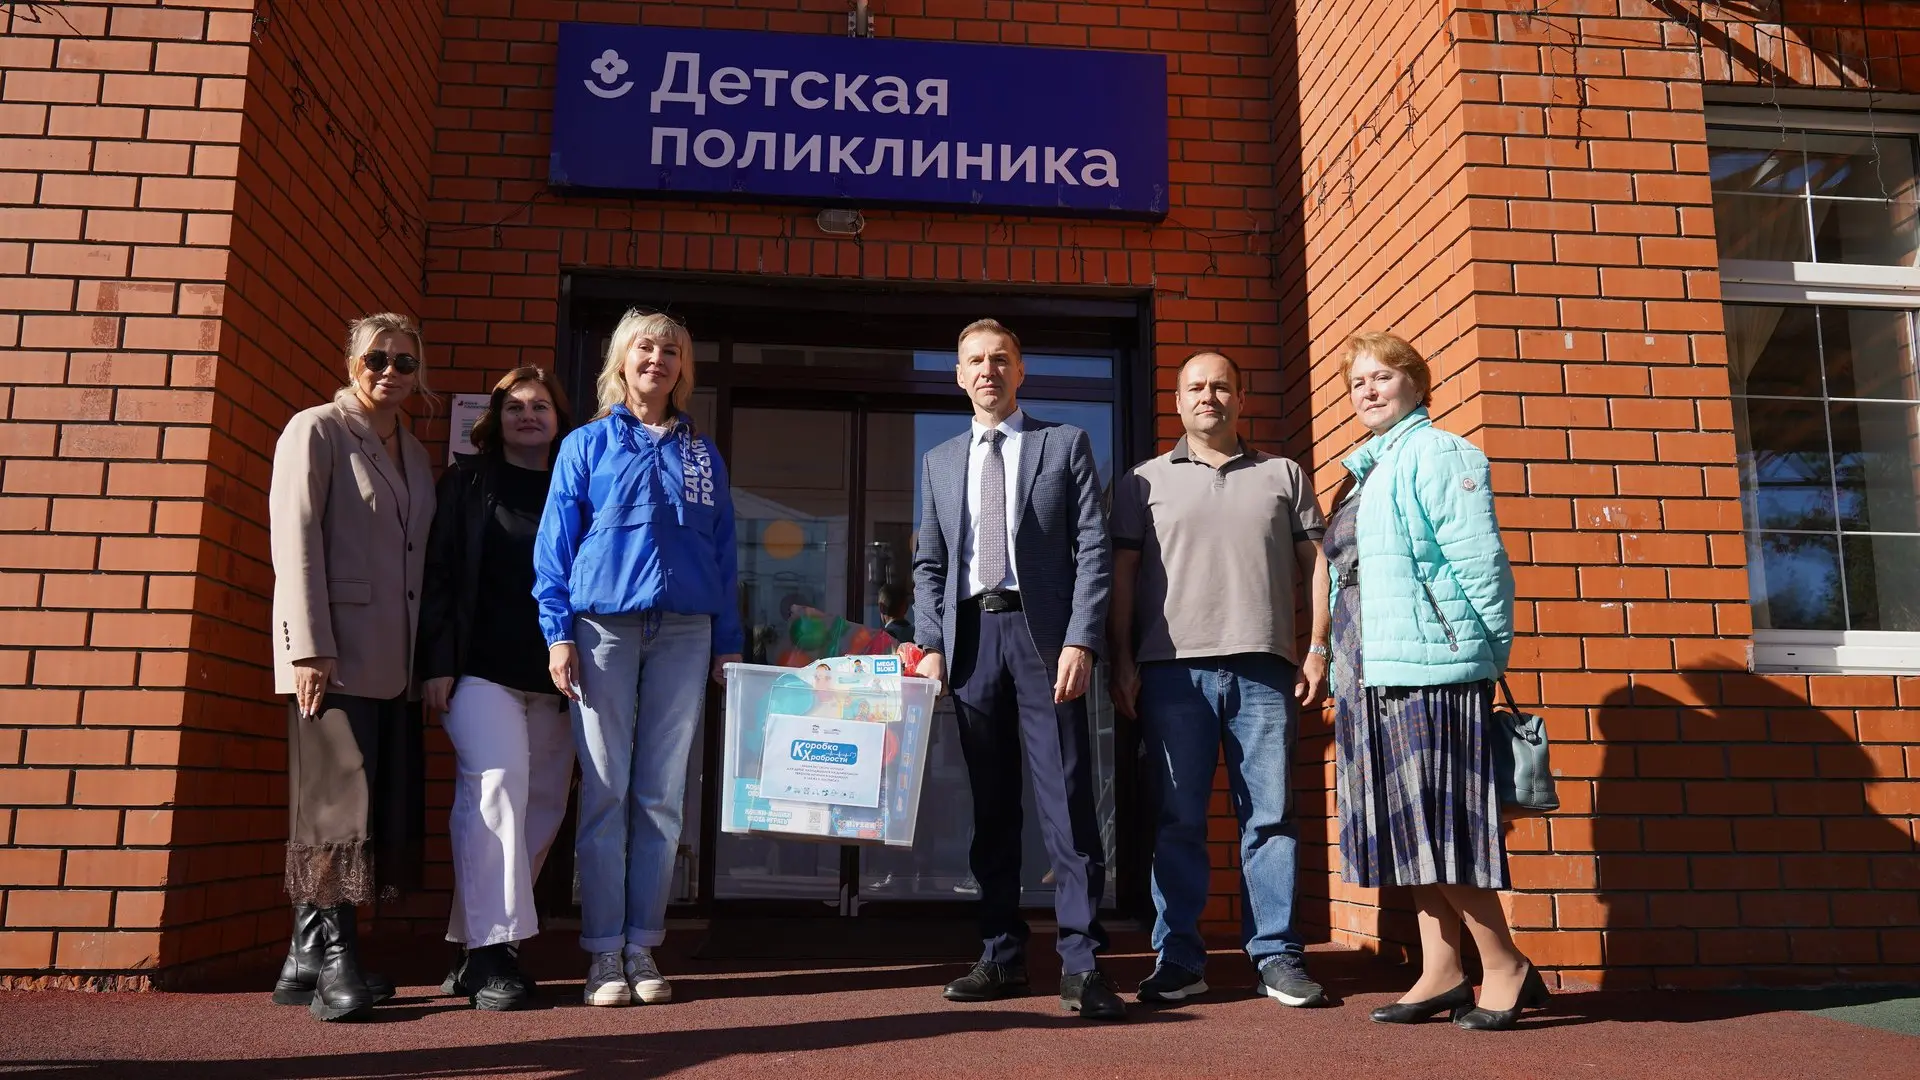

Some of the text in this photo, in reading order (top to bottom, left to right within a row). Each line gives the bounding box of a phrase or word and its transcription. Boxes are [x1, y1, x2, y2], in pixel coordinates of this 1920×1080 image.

[649, 51, 950, 116] Детская
[649, 125, 1120, 188] поликлиника
[691, 439, 715, 507] РОССИЯ
[793, 741, 839, 758] Коробка
[802, 749, 848, 763] Храбрости
